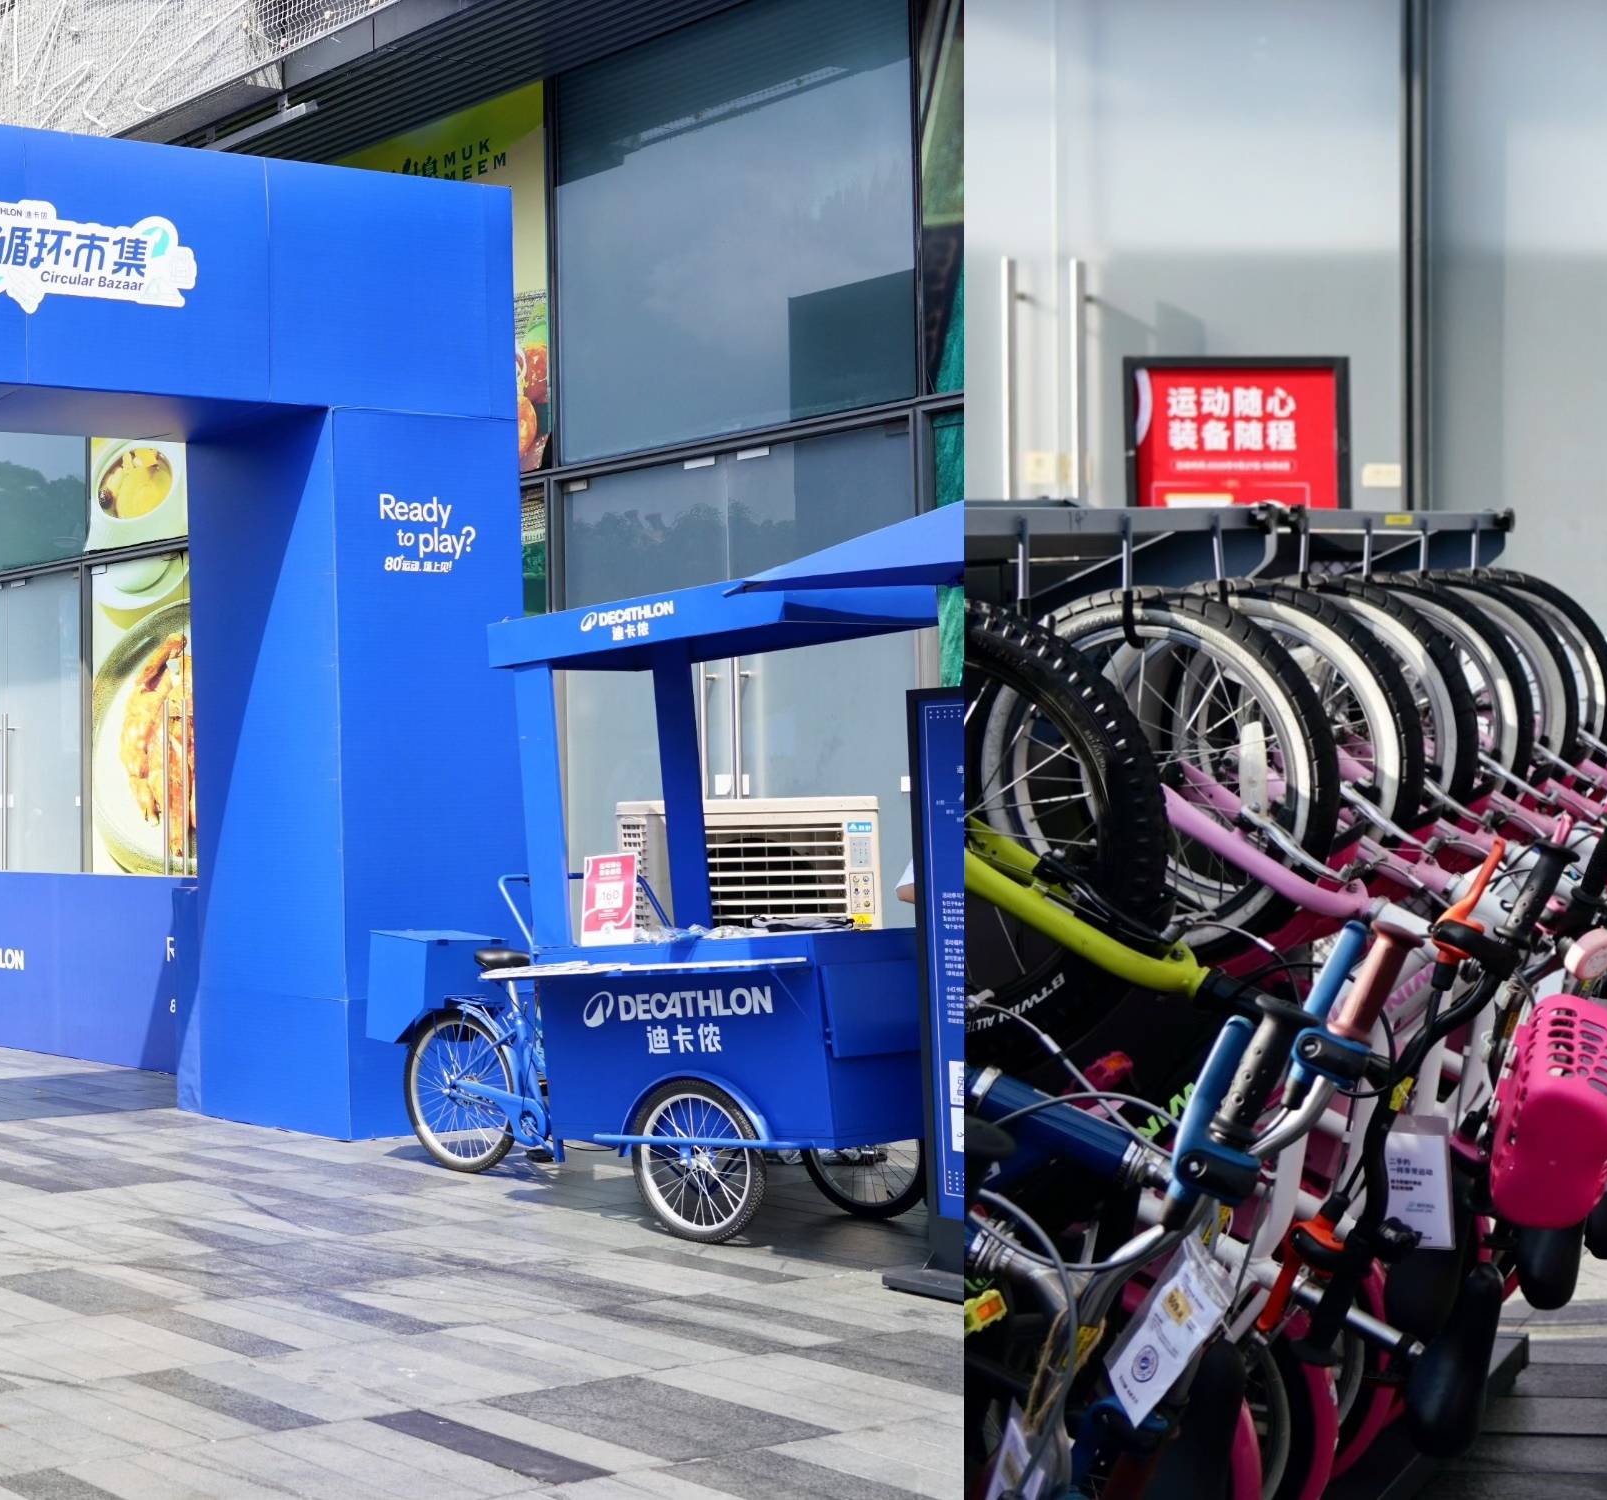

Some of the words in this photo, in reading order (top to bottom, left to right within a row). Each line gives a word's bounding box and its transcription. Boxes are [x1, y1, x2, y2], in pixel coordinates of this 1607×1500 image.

[444, 138, 490, 168] MUK
[39, 269, 95, 287] Circular
[97, 275, 144, 292] Bazaar
[1166, 385, 1297, 418] 运动随心
[1167, 419, 1297, 451] 装备随程
[379, 492, 452, 529] Ready
[396, 528, 415, 547] to
[419, 525, 476, 560] play?
[598, 600, 674, 627] DECATHLON
[617, 985, 774, 1022] DECATHLON
[646, 1022, 722, 1055] 迪卡侬
